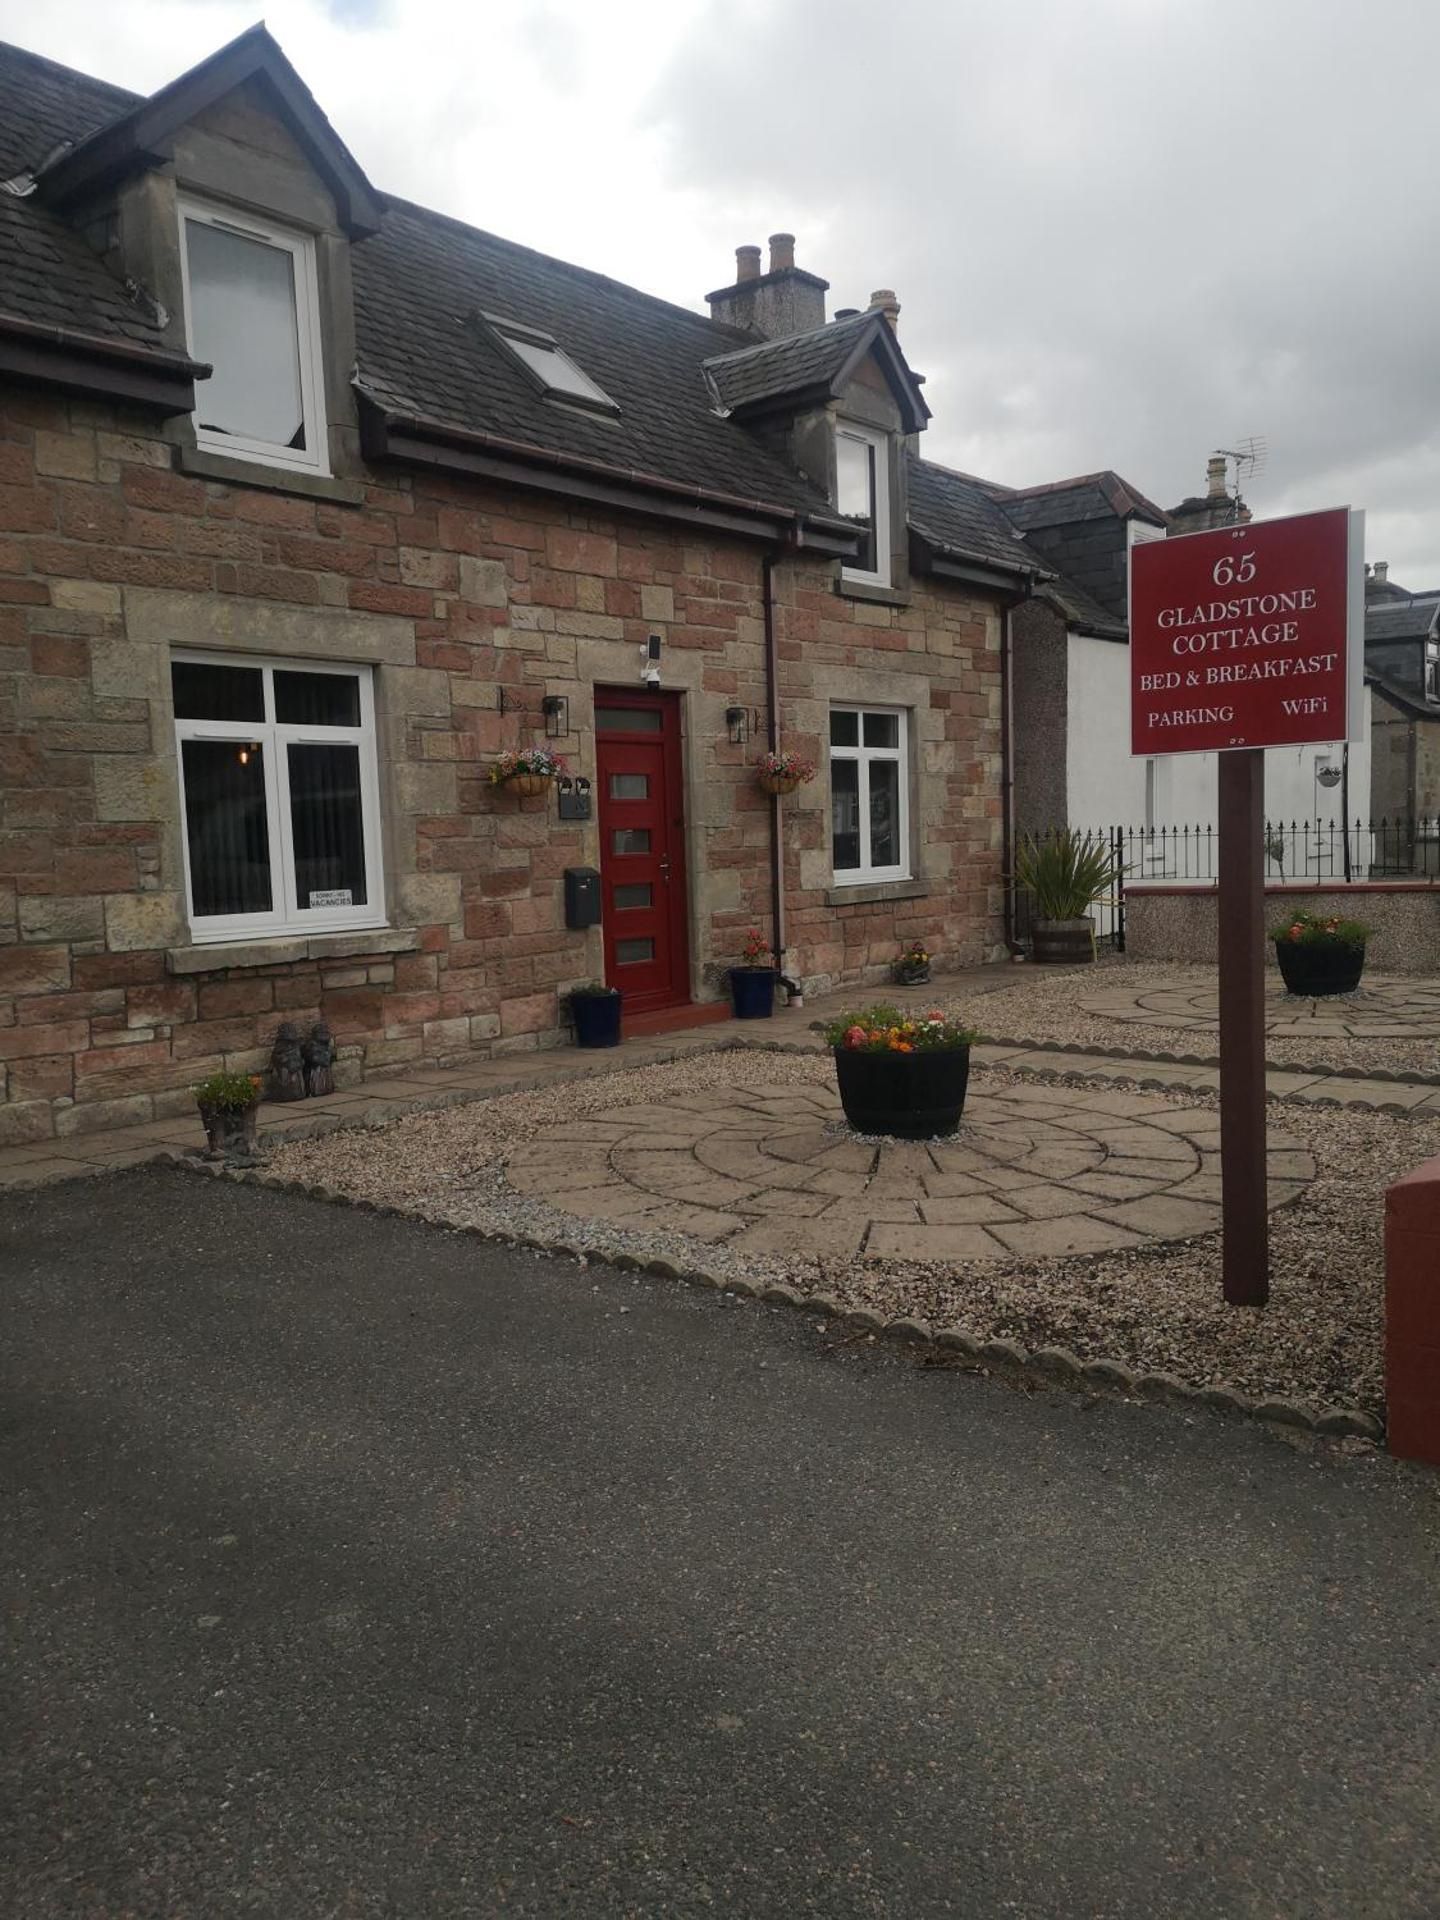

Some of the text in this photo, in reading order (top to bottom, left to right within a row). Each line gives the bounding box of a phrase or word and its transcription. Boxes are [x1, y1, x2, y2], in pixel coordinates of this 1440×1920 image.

[1211, 551, 1257, 586] 65
[1157, 588, 1318, 629] GLADSTONE
[1172, 621, 1300, 656] COTTAGE
[1140, 653, 1339, 692] BED & BREAKFAST
[1148, 706, 1235, 728] PARKING
[1281, 696, 1329, 715] WiFi
[310, 899, 352, 907] VACANCIES
